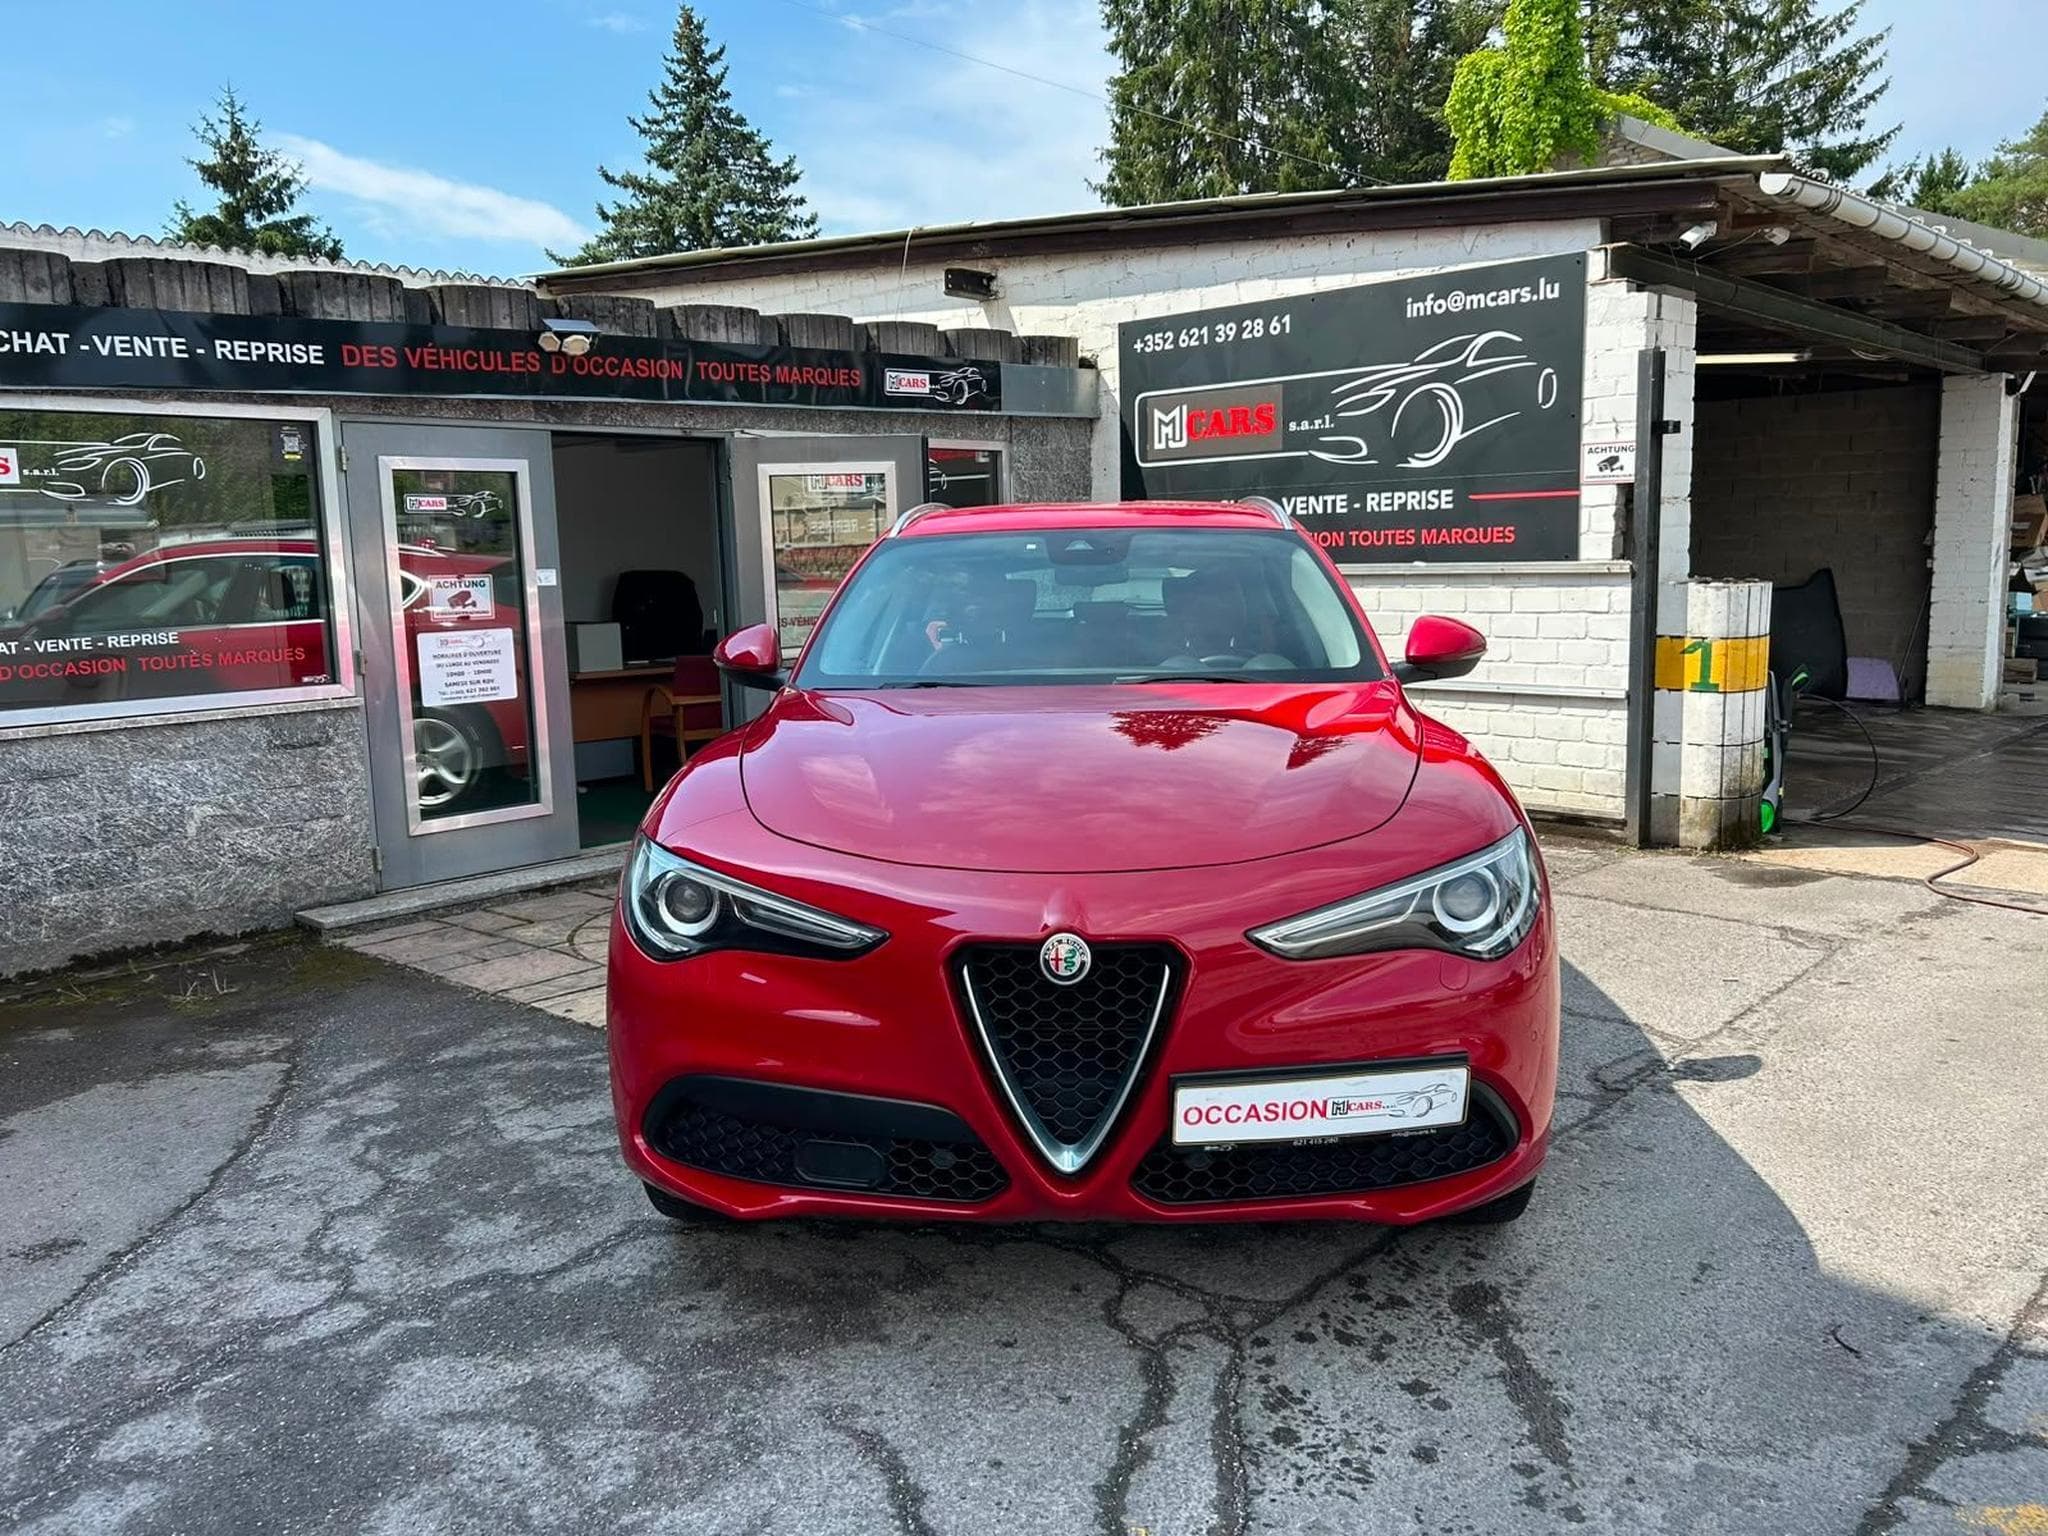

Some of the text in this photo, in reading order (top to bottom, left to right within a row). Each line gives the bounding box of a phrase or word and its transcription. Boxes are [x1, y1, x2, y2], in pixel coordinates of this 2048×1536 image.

[1406, 277, 1560, 318] info@mcars.lu
[1133, 314, 1291, 353] +352 621 39 28 61
[215, 339, 325, 365] REPRISE
[342, 345, 397, 368] DES
[405, 343, 540, 372] VÉHICULES
[551, 352, 683, 379] D'OCCASION
[696, 361, 771, 382] TOUTES
[776, 366, 861, 387] MARQUES
[1187, 403, 1276, 440] CARS
[1289, 414, 1334, 432] s.a.r.l.
[1587, 444, 1635, 454] ACHTUNG
[827, 474, 863, 487] CARS
[1282, 495, 1347, 515] VENTE
[1366, 489, 1453, 512] REPRISE
[1310, 527, 1515, 547] ION TOUTES MARQUES
[436, 580, 486, 589] ACHTUNG
[34, 637, 93, 653] VENTE
[107, 632, 180, 649] REPRISE
[0, 647, 306, 680] D'OCCASION TOUTES MARQUES
[1680, 640, 1720, 692] 1
[1183, 1100, 1328, 1125] OCCASION
[1348, 1101, 1383, 1112] CARS
